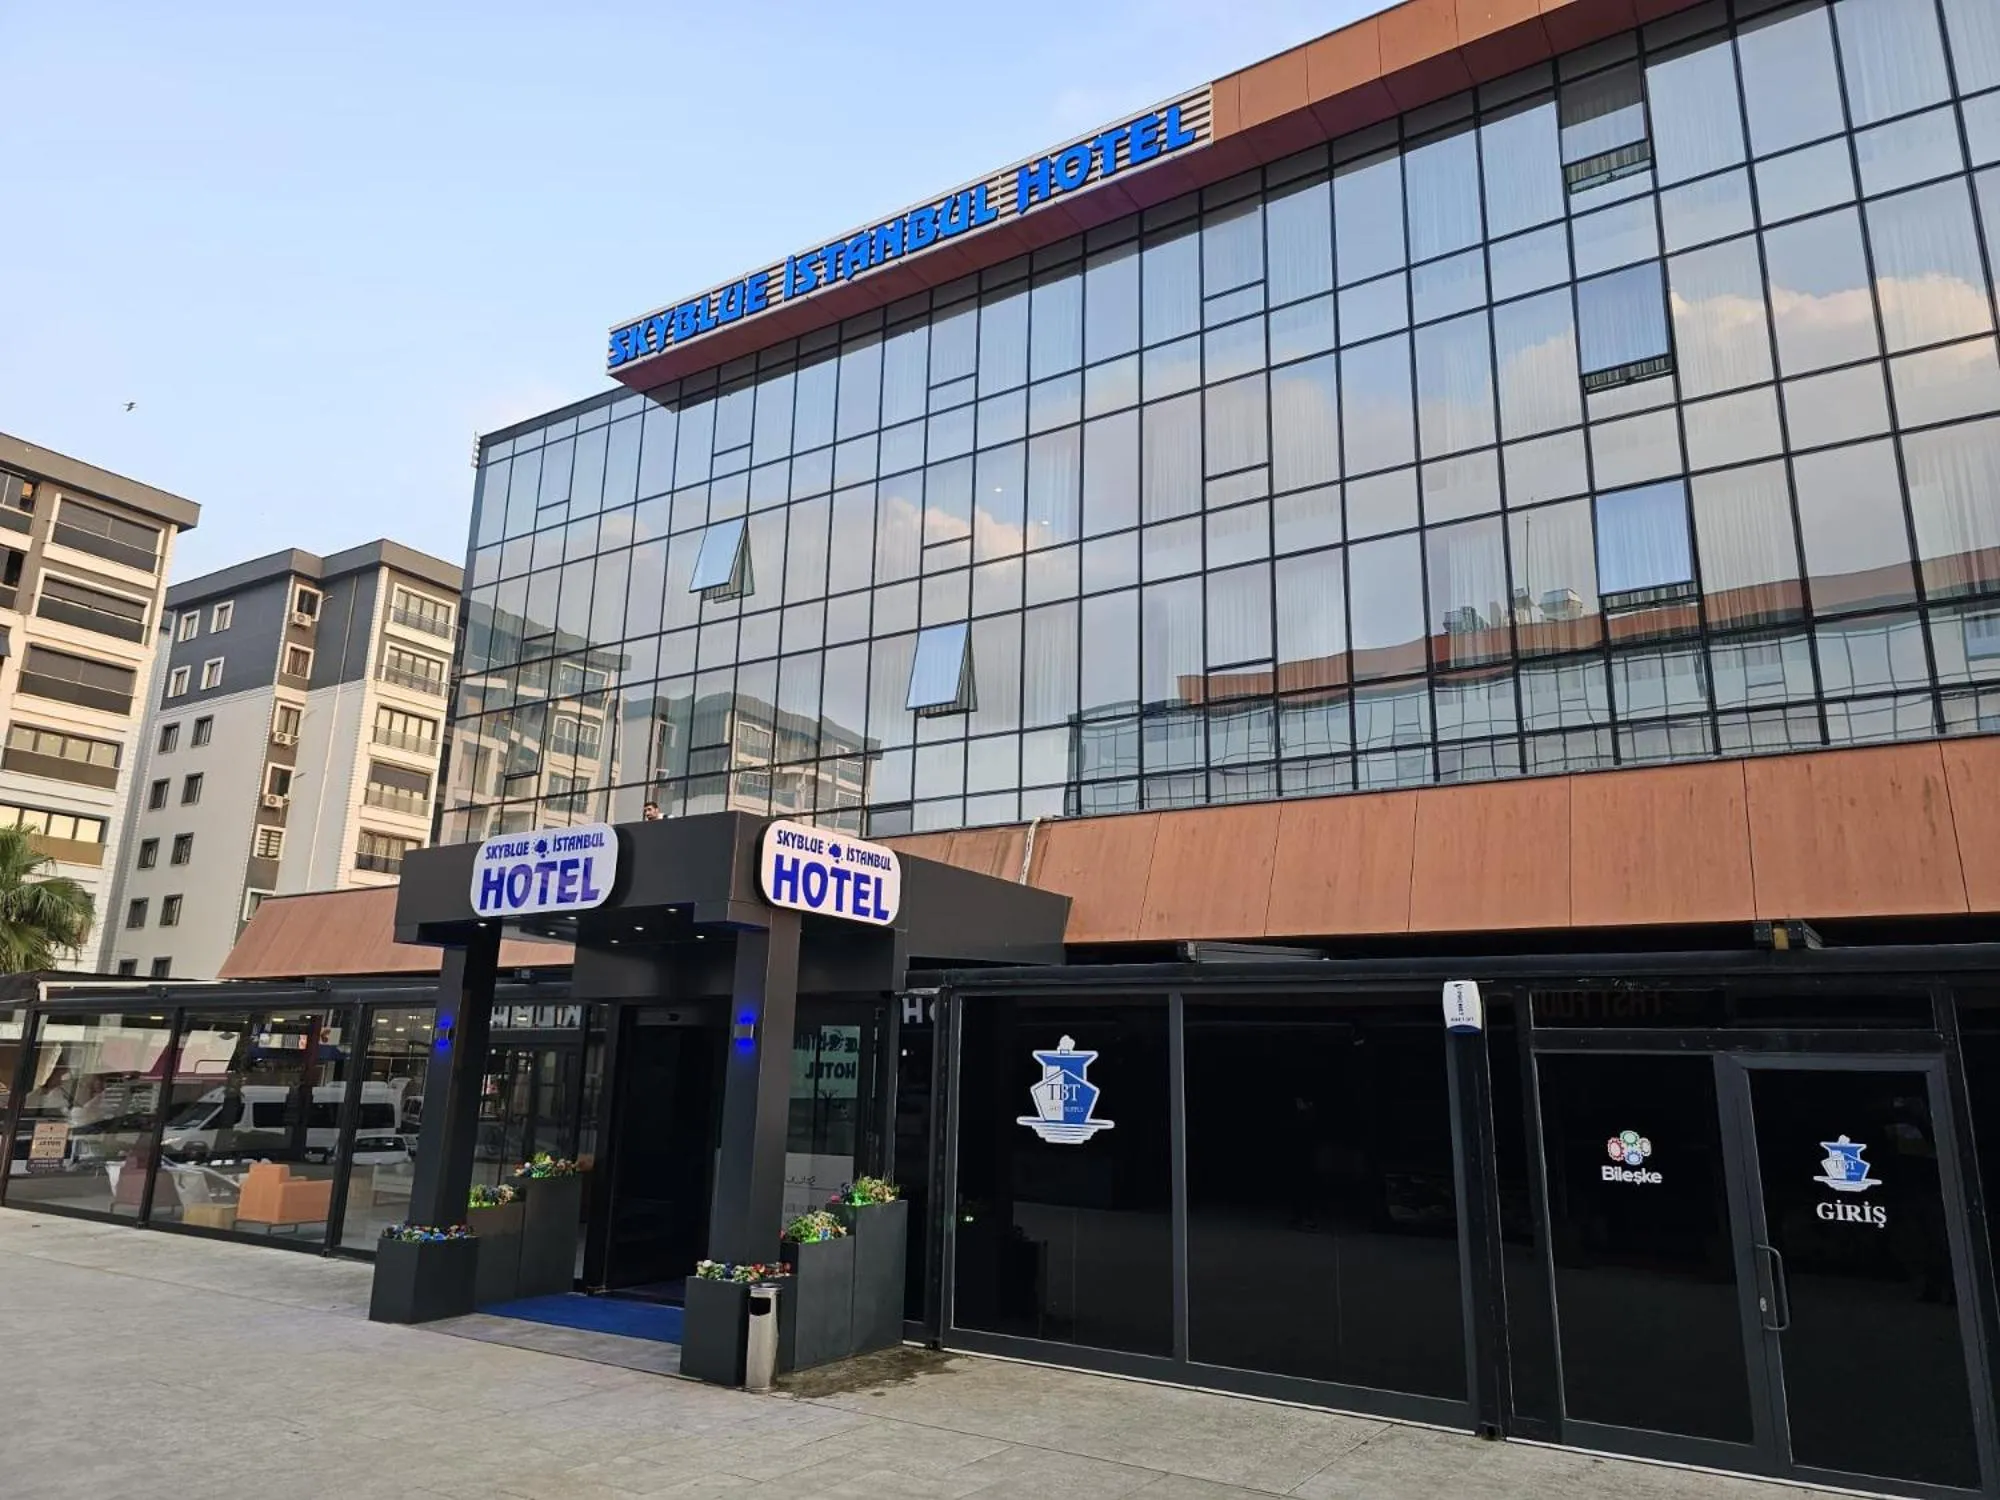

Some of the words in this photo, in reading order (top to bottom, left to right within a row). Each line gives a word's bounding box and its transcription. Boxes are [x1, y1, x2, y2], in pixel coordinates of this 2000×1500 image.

[608, 271, 769, 366] SKYBLUE
[1015, 105, 1196, 213] HOTEL
[485, 839, 529, 861] SKYBLUE
[776, 828, 824, 856] SKYBLUE
[479, 857, 601, 911] HOTEL
[772, 854, 890, 921] HOTEL
[1047, 1083, 1081, 1101] TBT
[1601, 1165, 1663, 1186] Bileşke
[1816, 1200, 1888, 1229] GİRİŞ
